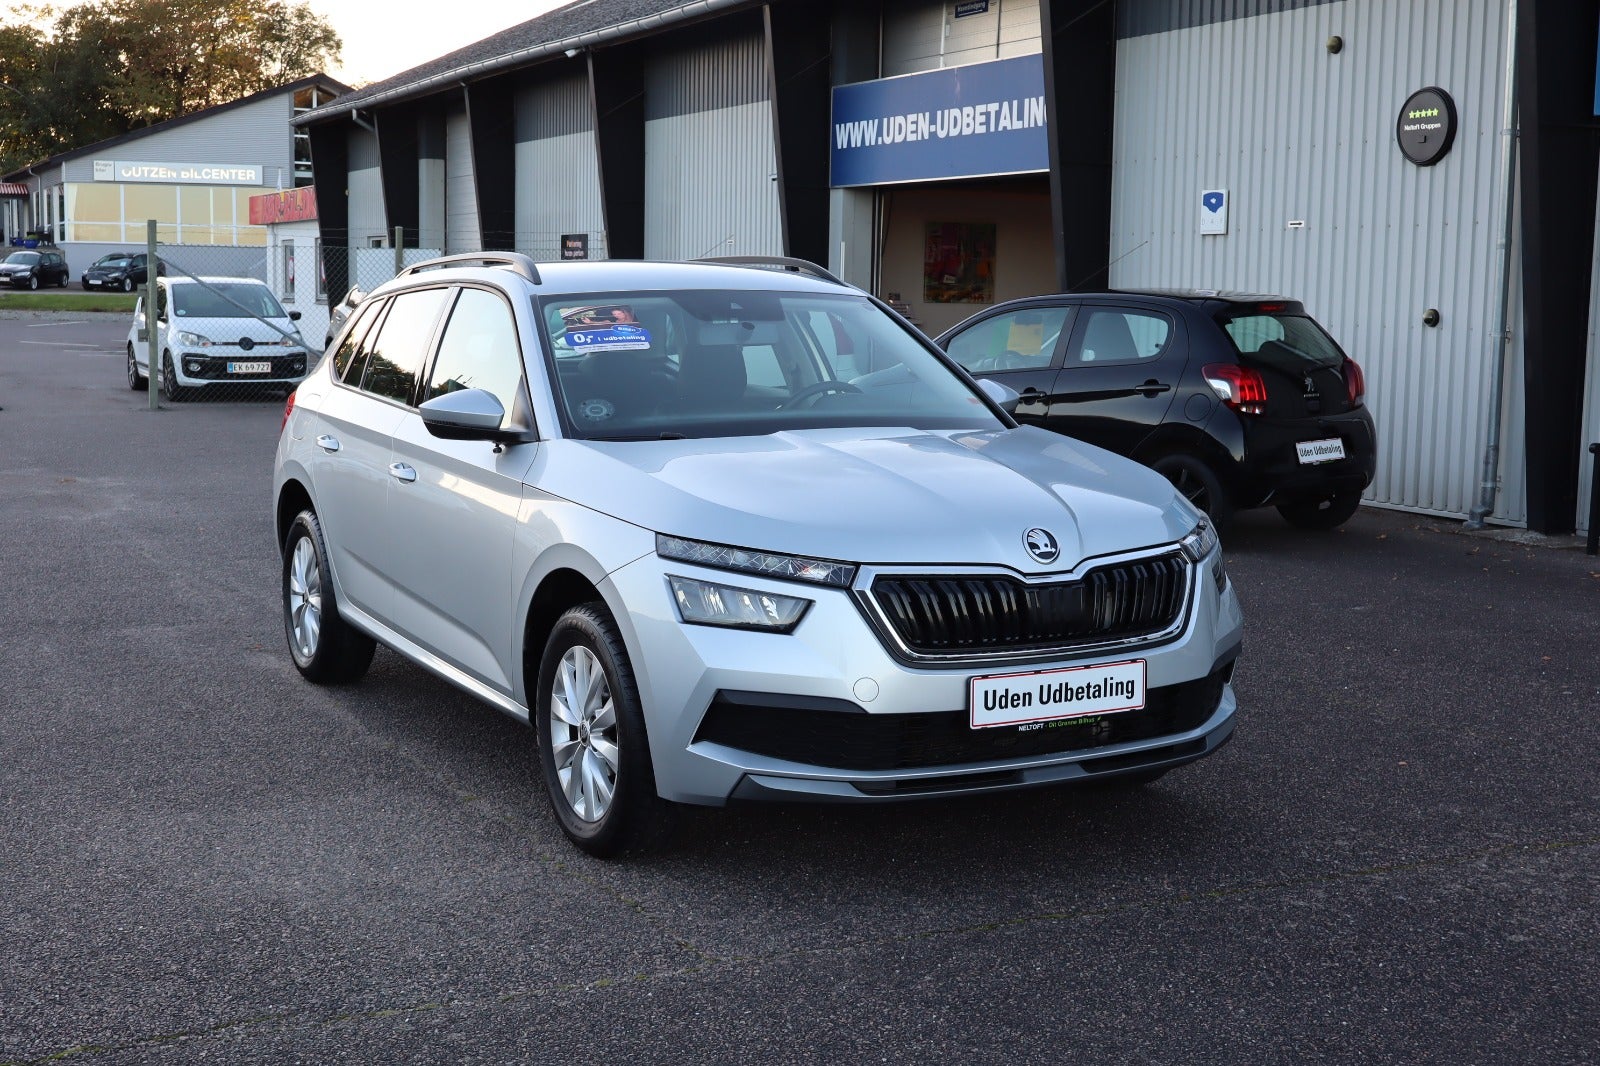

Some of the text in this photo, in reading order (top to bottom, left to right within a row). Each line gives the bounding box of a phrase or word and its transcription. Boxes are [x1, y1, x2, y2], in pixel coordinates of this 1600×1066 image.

[835, 96, 1048, 150] WWW.UDEN-UDBETALIN
[1421, 122, 1441, 131] Gruppen
[1299, 444, 1342, 457] Uden Udbetaling
[983, 677, 1135, 711] Uden Udbetaling
[1018, 723, 1044, 731] NELTOFT
